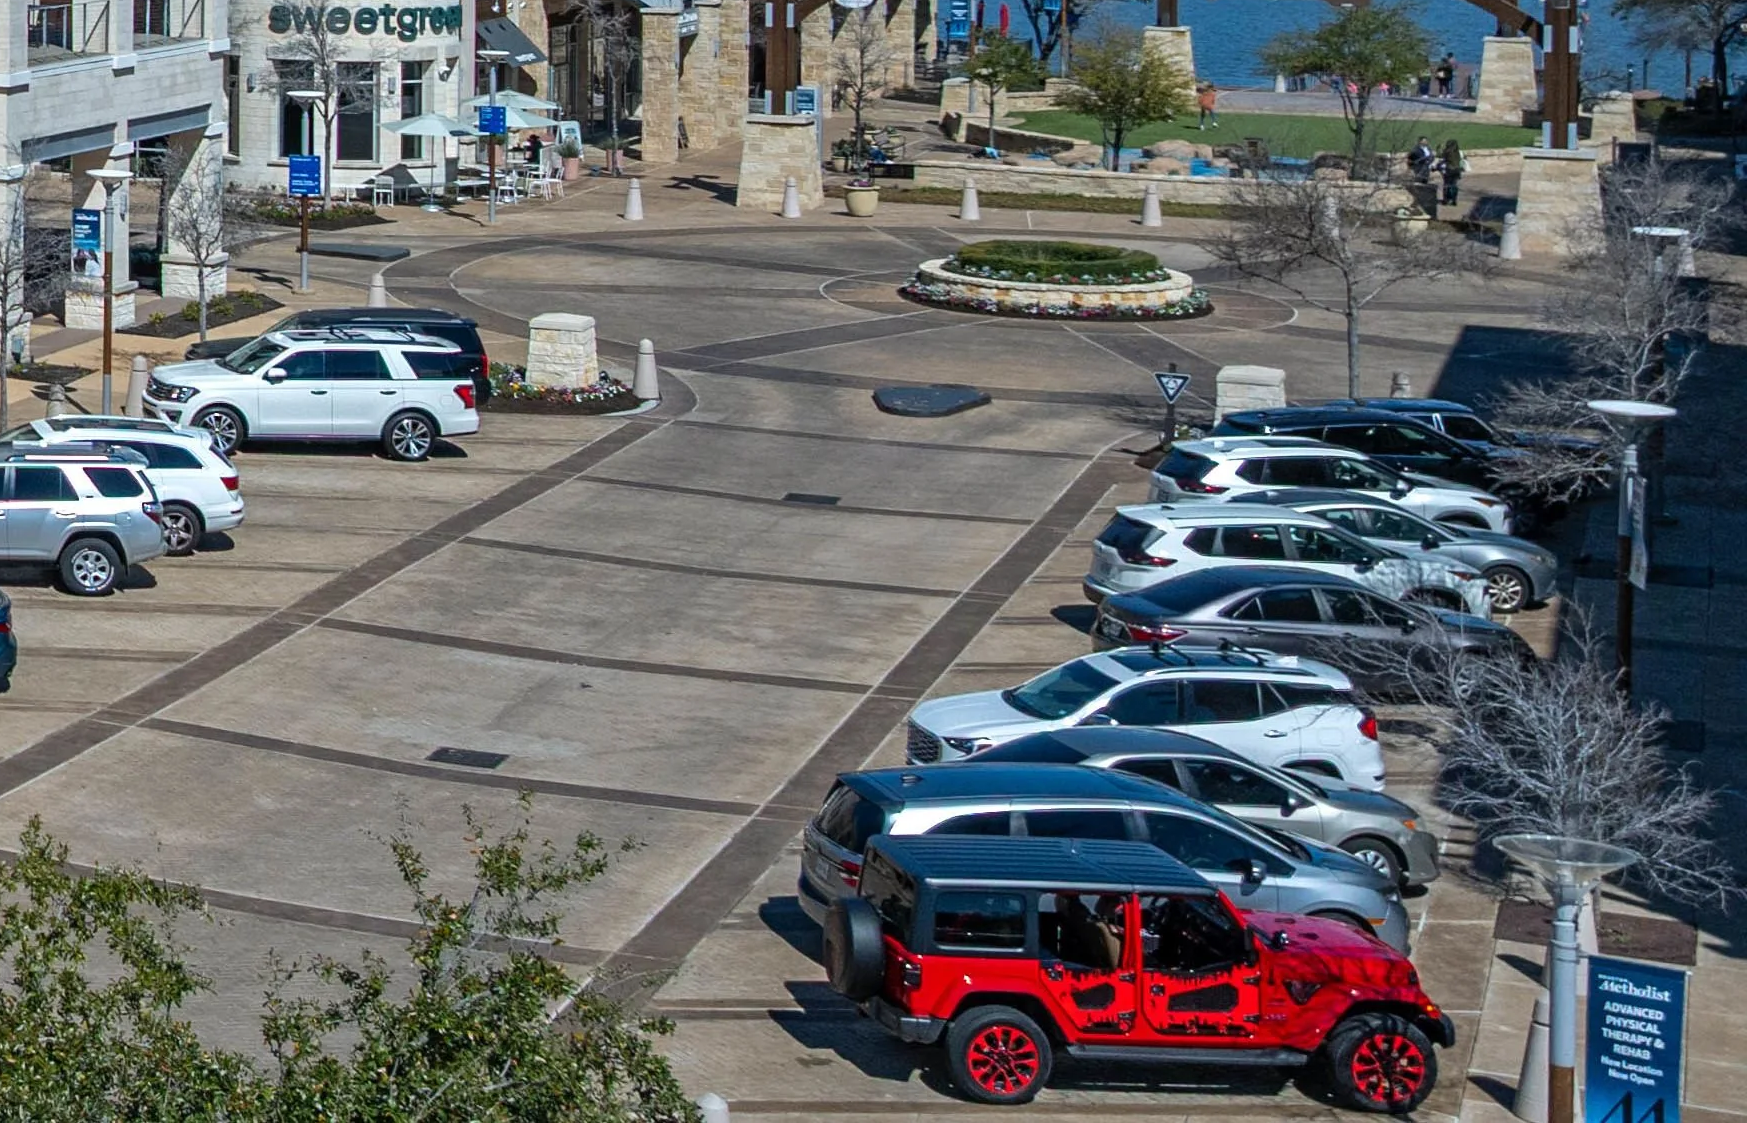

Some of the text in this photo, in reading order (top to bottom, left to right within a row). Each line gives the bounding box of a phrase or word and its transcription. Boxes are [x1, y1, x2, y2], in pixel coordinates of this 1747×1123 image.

[1599, 979, 1671, 1002] Methodist
[1604, 1001, 1665, 1021] ADVANCED
[1605, 1015, 1661, 1035] PHYSICAL
[1601, 1027, 1665, 1049] THERAPY &
[1613, 1043, 1651, 1060] REHAB
[1622, 1059, 1663, 1076] Location
[1630, 1073, 1655, 1086] Open
